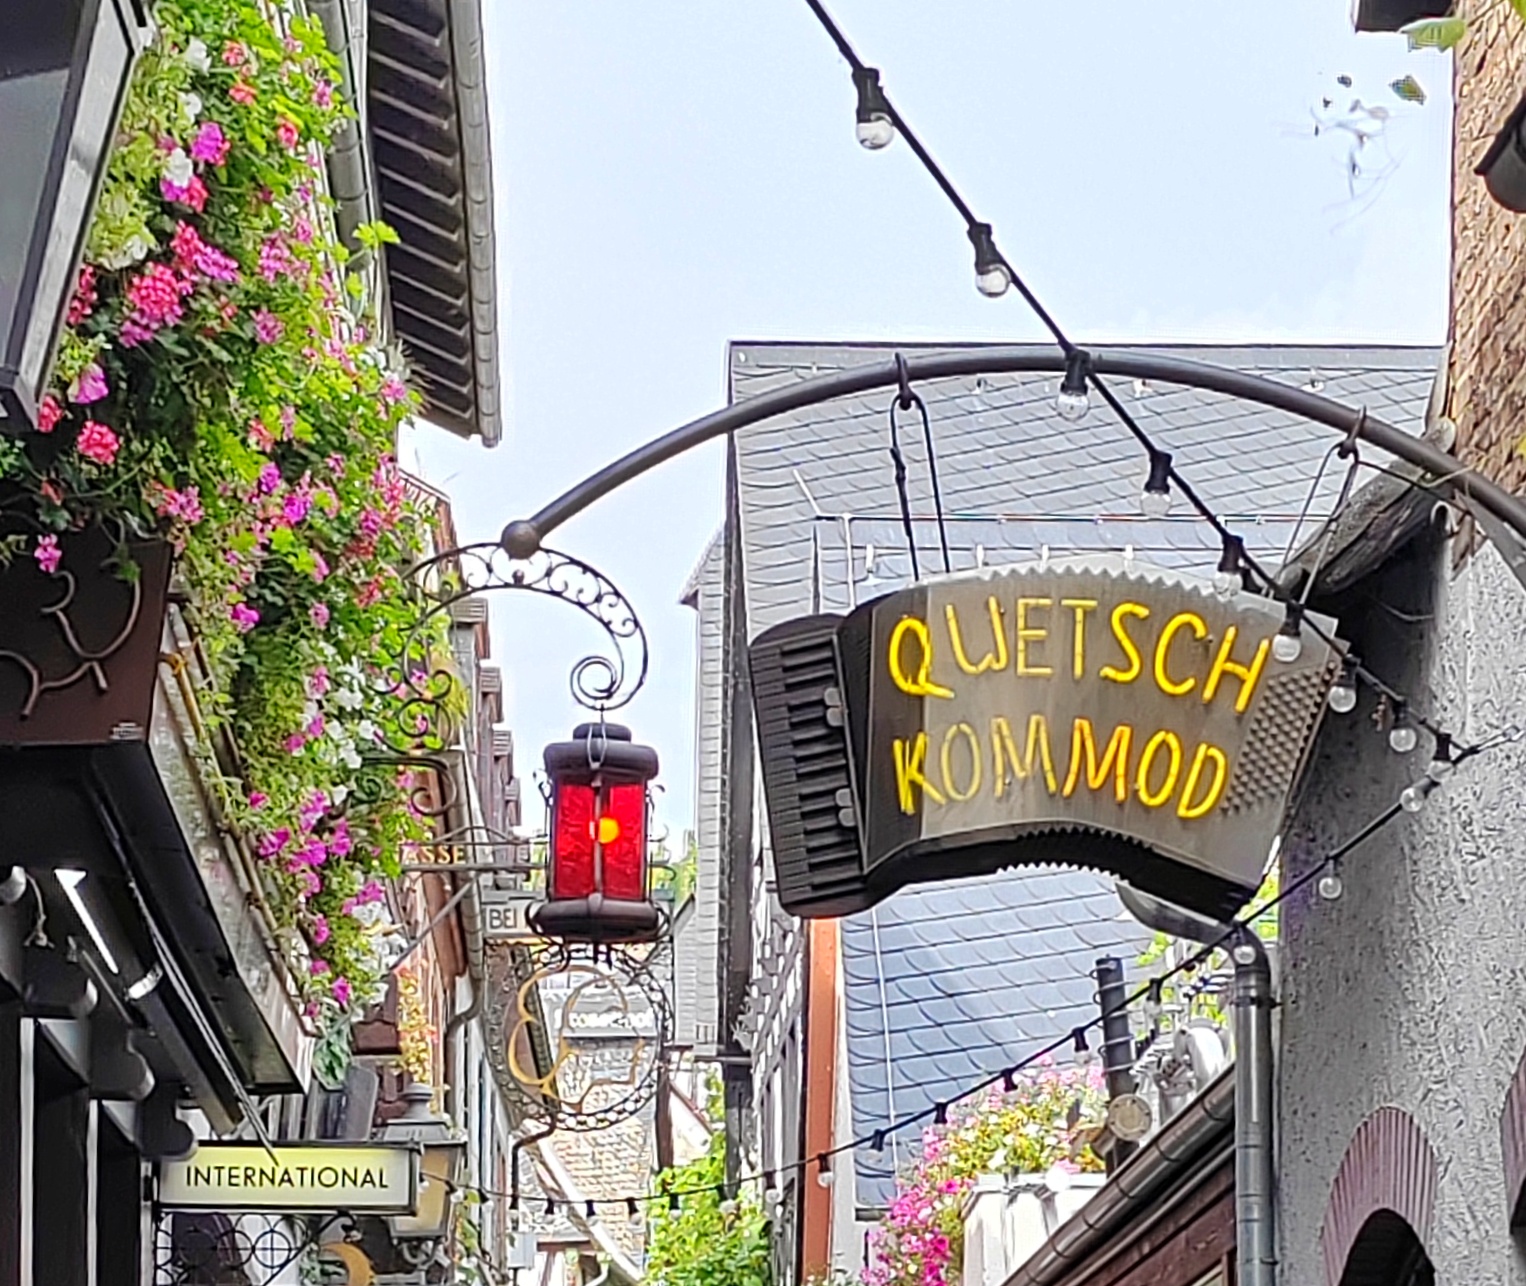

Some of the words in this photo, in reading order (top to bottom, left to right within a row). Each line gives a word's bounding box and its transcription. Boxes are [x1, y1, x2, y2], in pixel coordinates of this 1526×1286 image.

[888, 596, 1271, 713] QUETSCH
[893, 714, 1228, 818] KOMMOD
[185, 1165, 389, 1188] INTERNATIONAL
